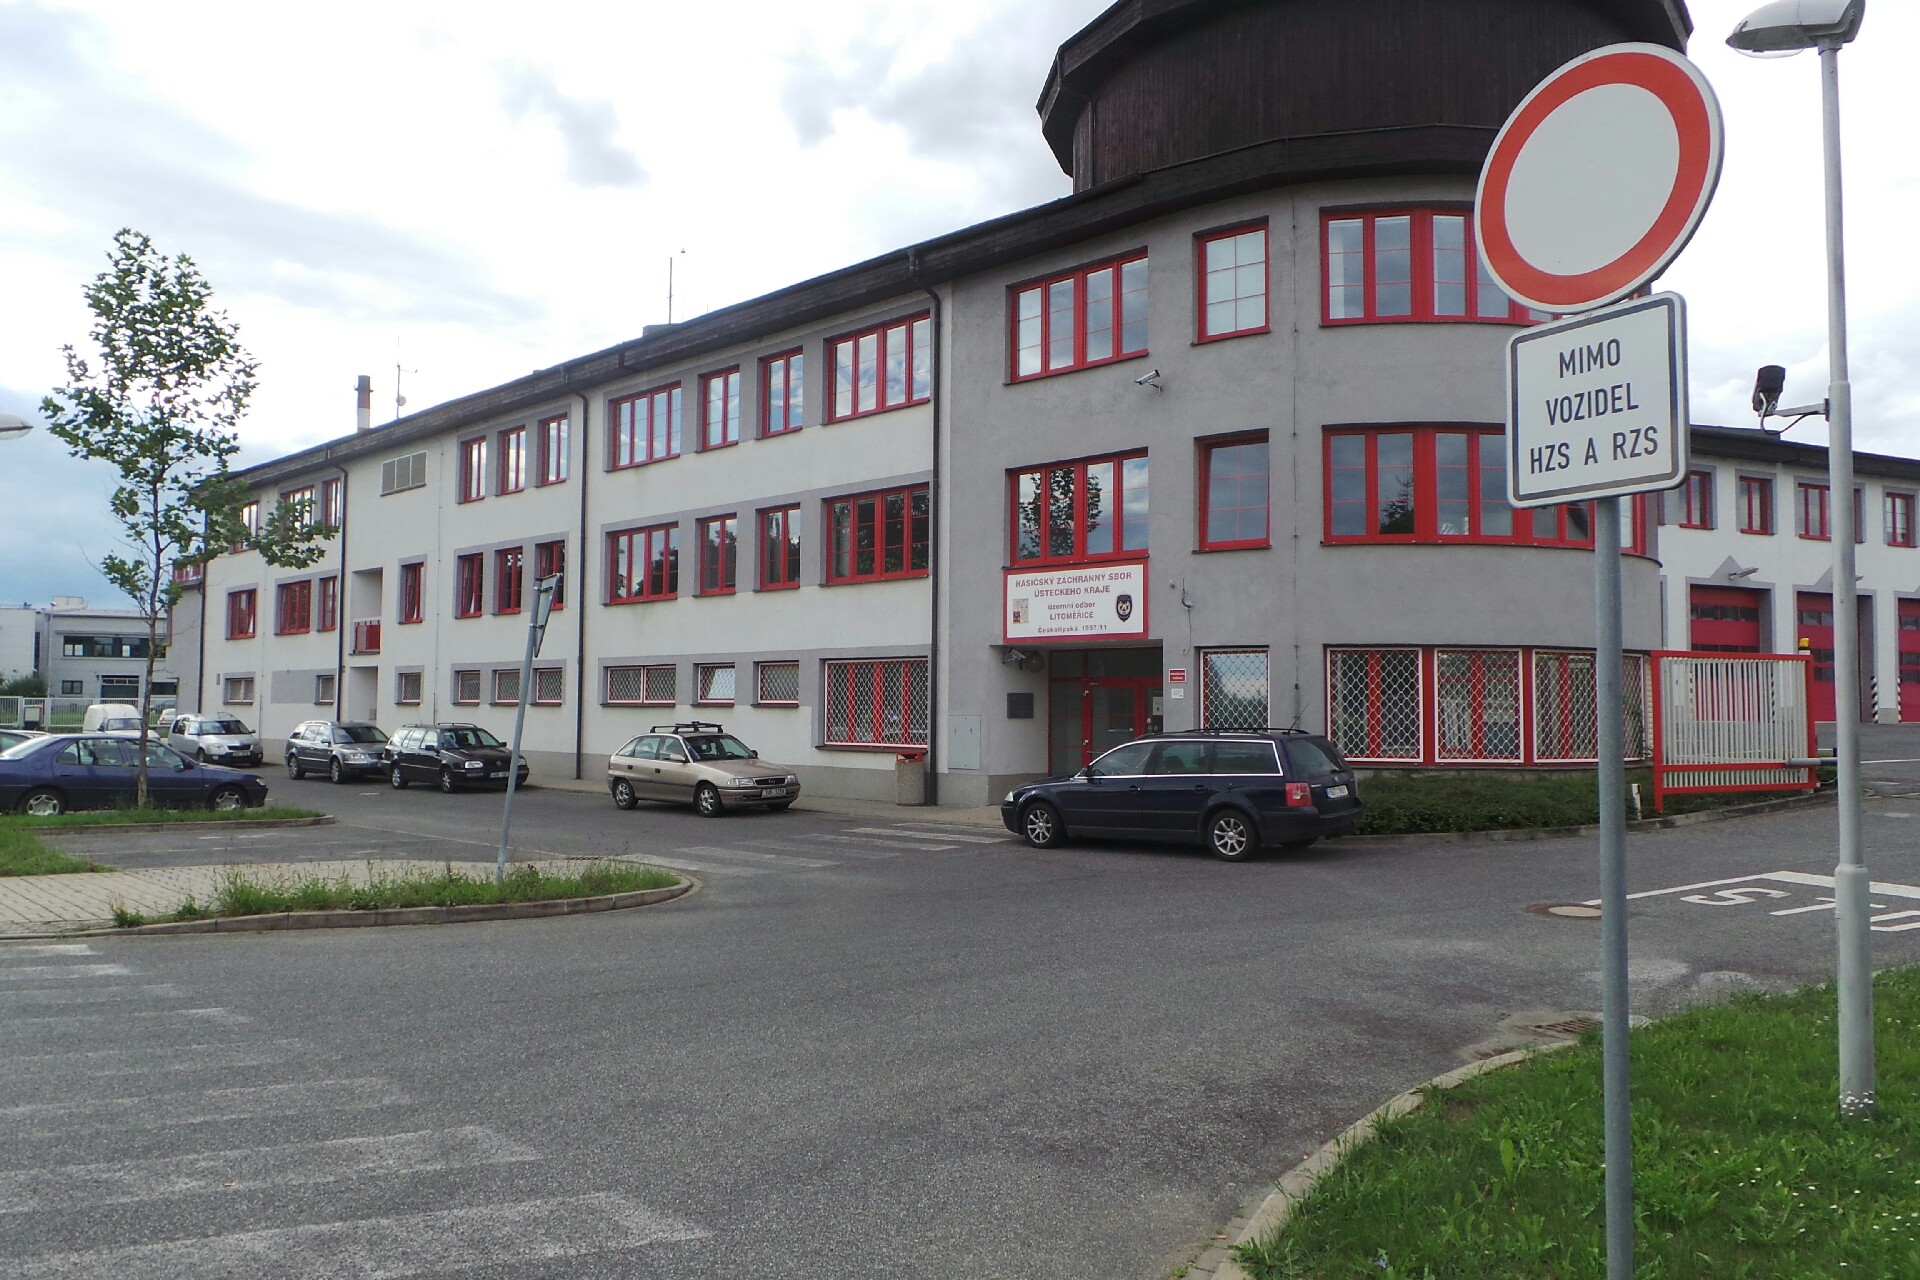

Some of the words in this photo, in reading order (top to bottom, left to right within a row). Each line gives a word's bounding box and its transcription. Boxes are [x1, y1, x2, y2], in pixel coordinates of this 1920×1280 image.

[1559, 338, 1621, 378] MIMO
[1546, 382, 1639, 426] VOZIDEL
[1530, 442, 1570, 475] HZS
[1584, 437, 1599, 466] A
[1612, 425, 1658, 461] RZS
[1056, 572, 1105, 585] ZÁCHRANNÝ
[1108, 571, 1132, 581] SBOR
[1084, 585, 1111, 595] KRAJE
[1075, 601, 1096, 609] odbor
